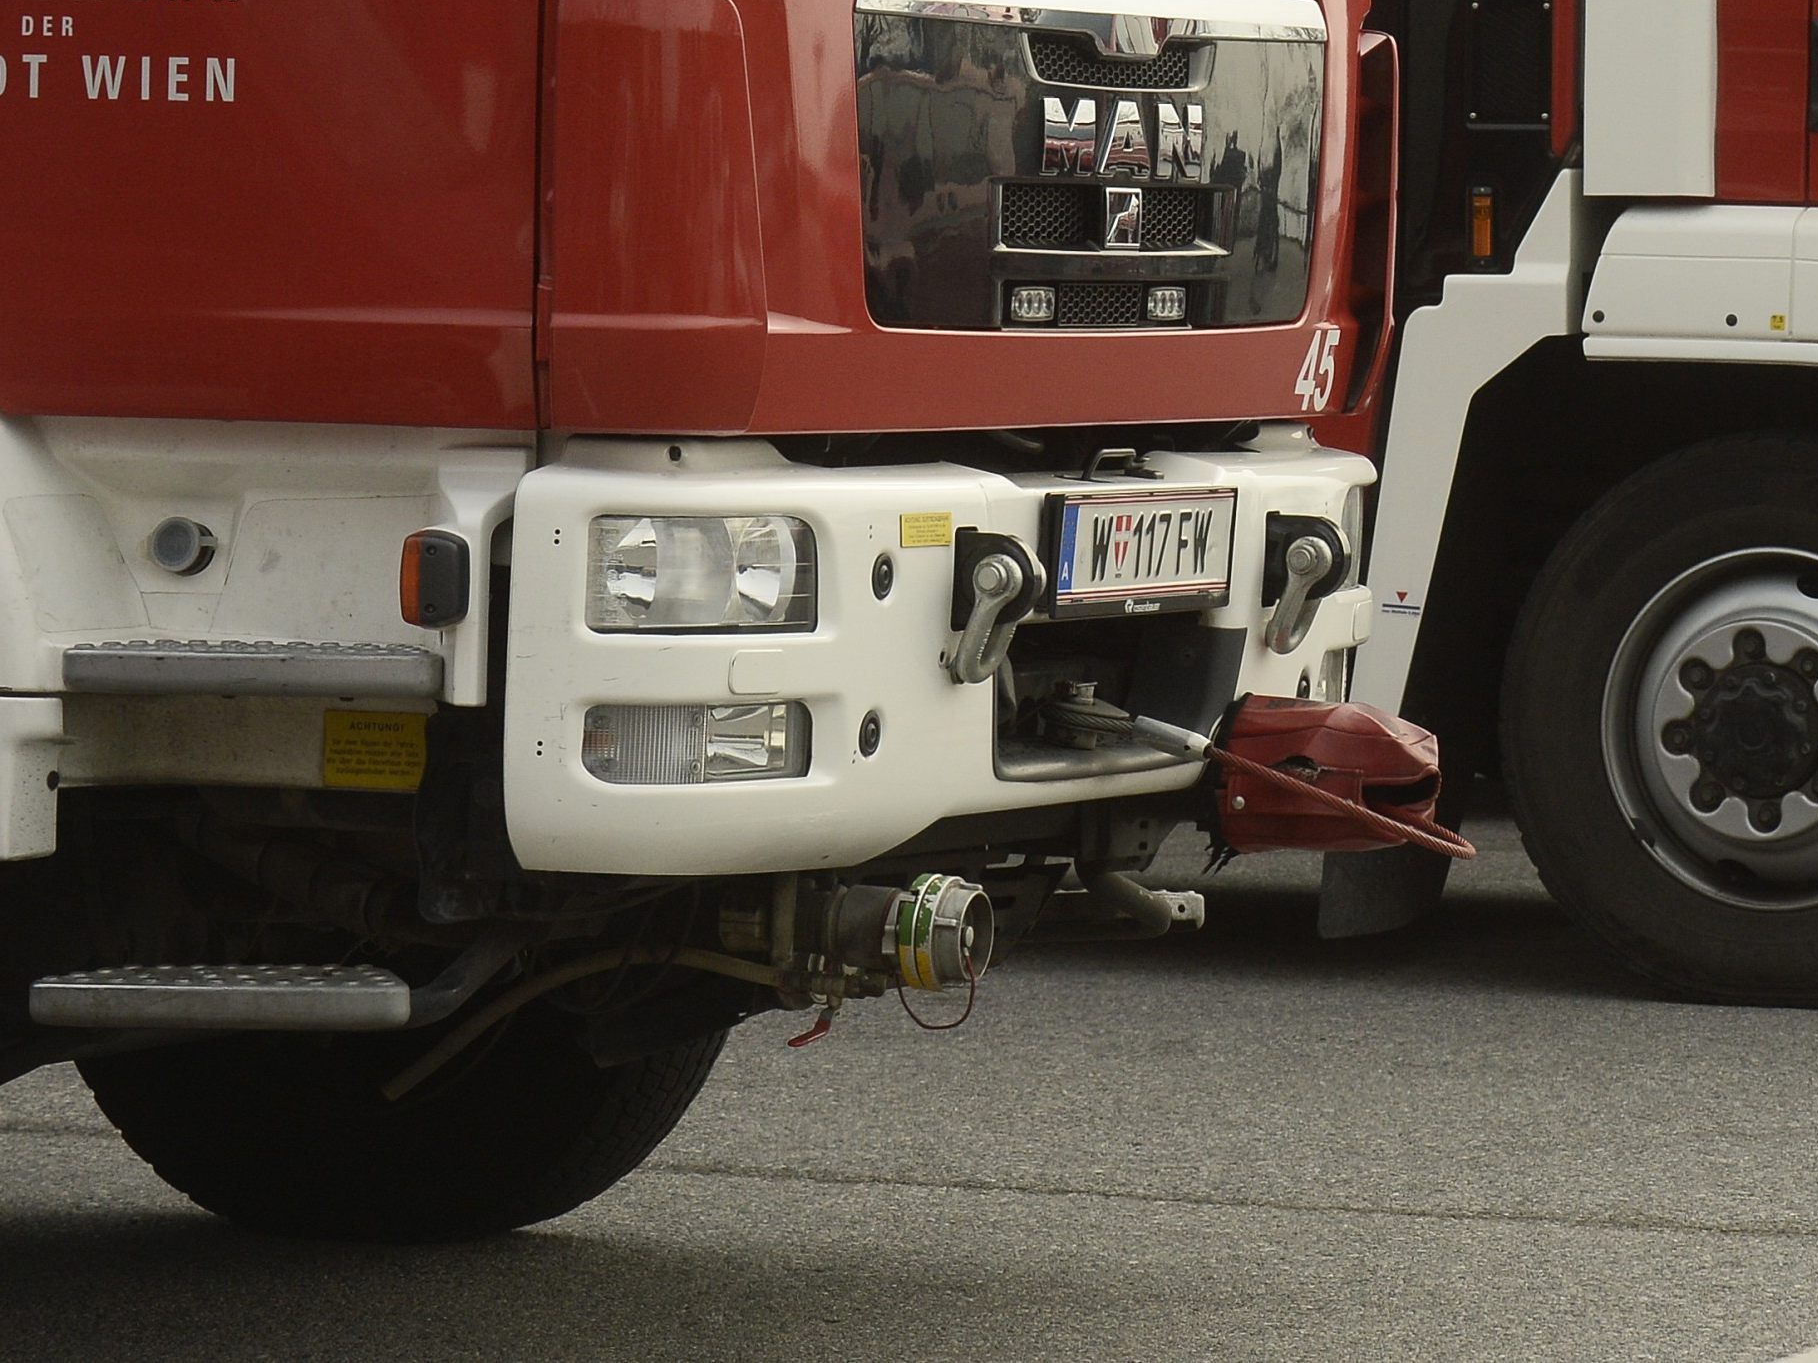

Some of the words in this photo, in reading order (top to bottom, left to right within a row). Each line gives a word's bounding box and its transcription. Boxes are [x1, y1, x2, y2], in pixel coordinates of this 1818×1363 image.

[21, 15, 74, 37] DER
[81, 55, 236, 102] WIEN
[1039, 96, 1202, 180] MAN
[1295, 329, 1340, 412] 45
[1061, 562, 1070, 581] A
[1090, 513, 1114, 582] W
[1132, 509, 1173, 580] 117
[1175, 507, 1213, 576] FW
